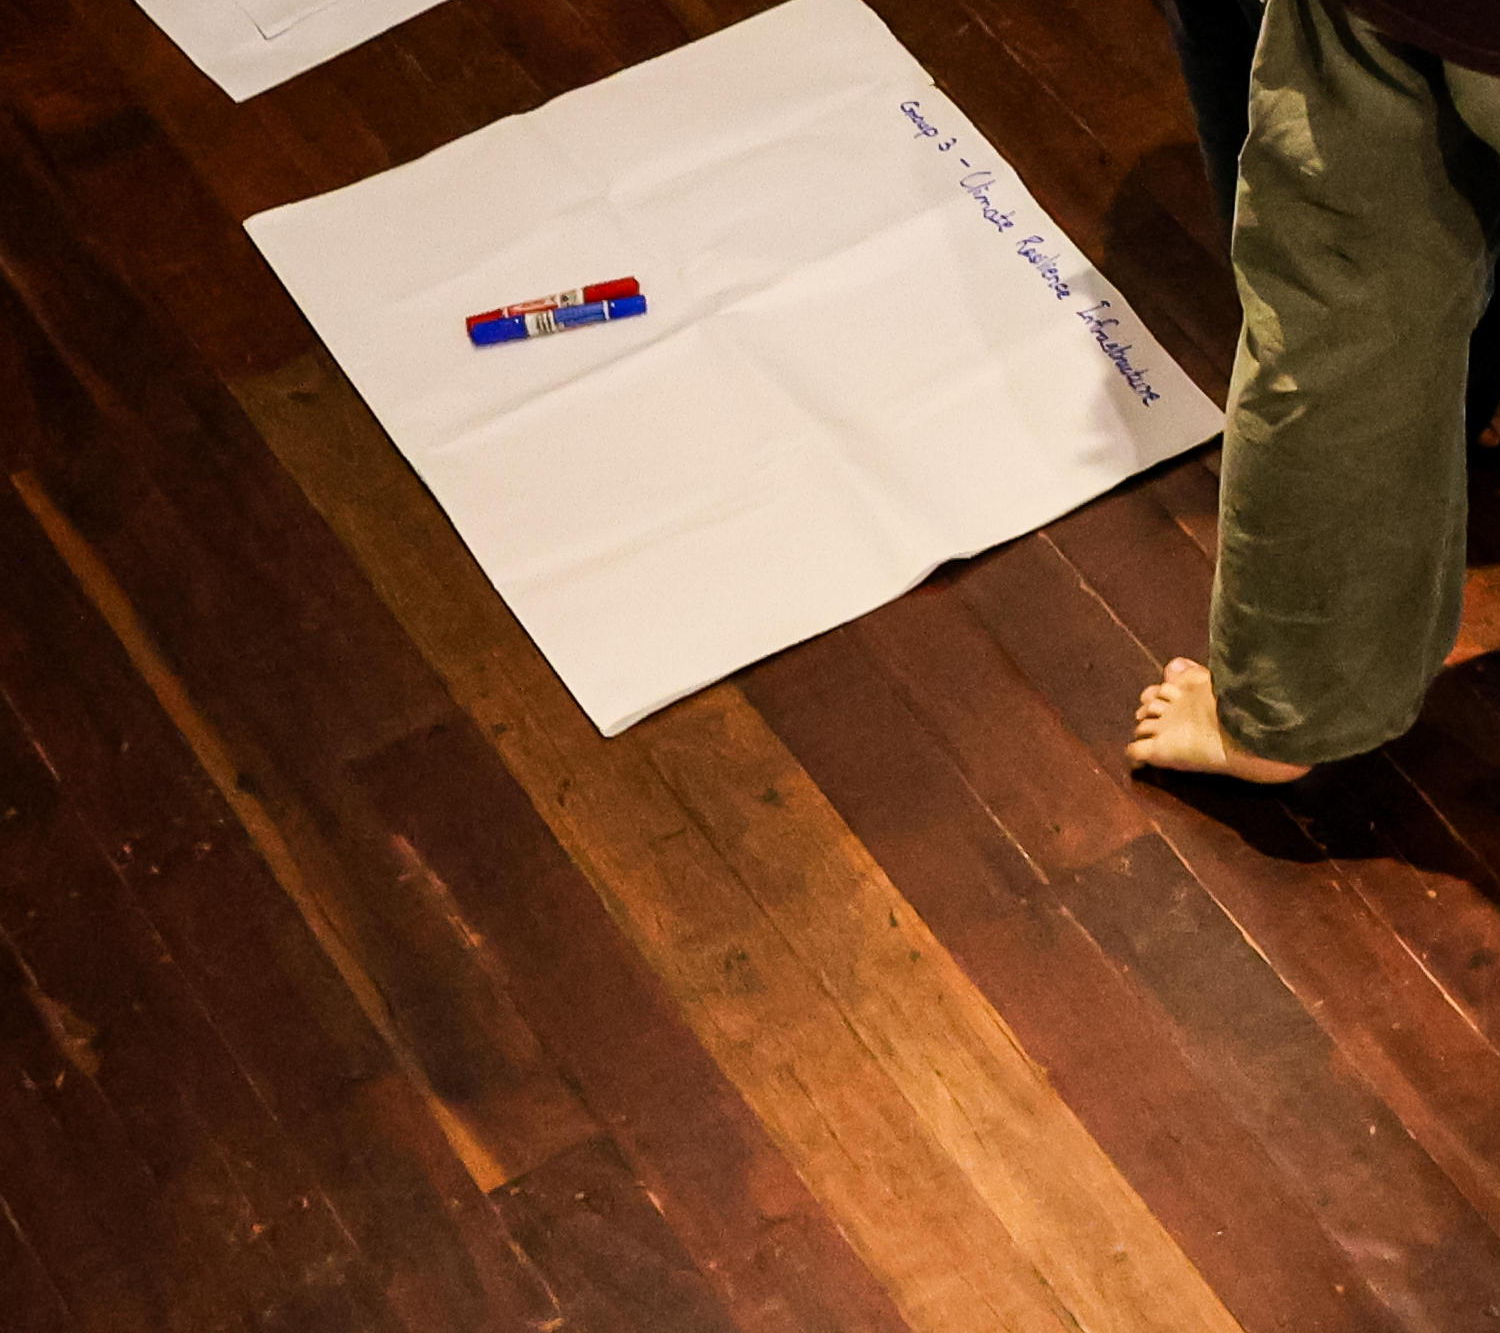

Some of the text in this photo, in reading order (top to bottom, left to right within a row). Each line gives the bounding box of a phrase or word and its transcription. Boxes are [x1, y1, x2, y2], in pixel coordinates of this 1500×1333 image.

[898, 100, 940, 139] Group
[937, 136, 959, 153] 3
[958, 170, 1016, 234] Climate
